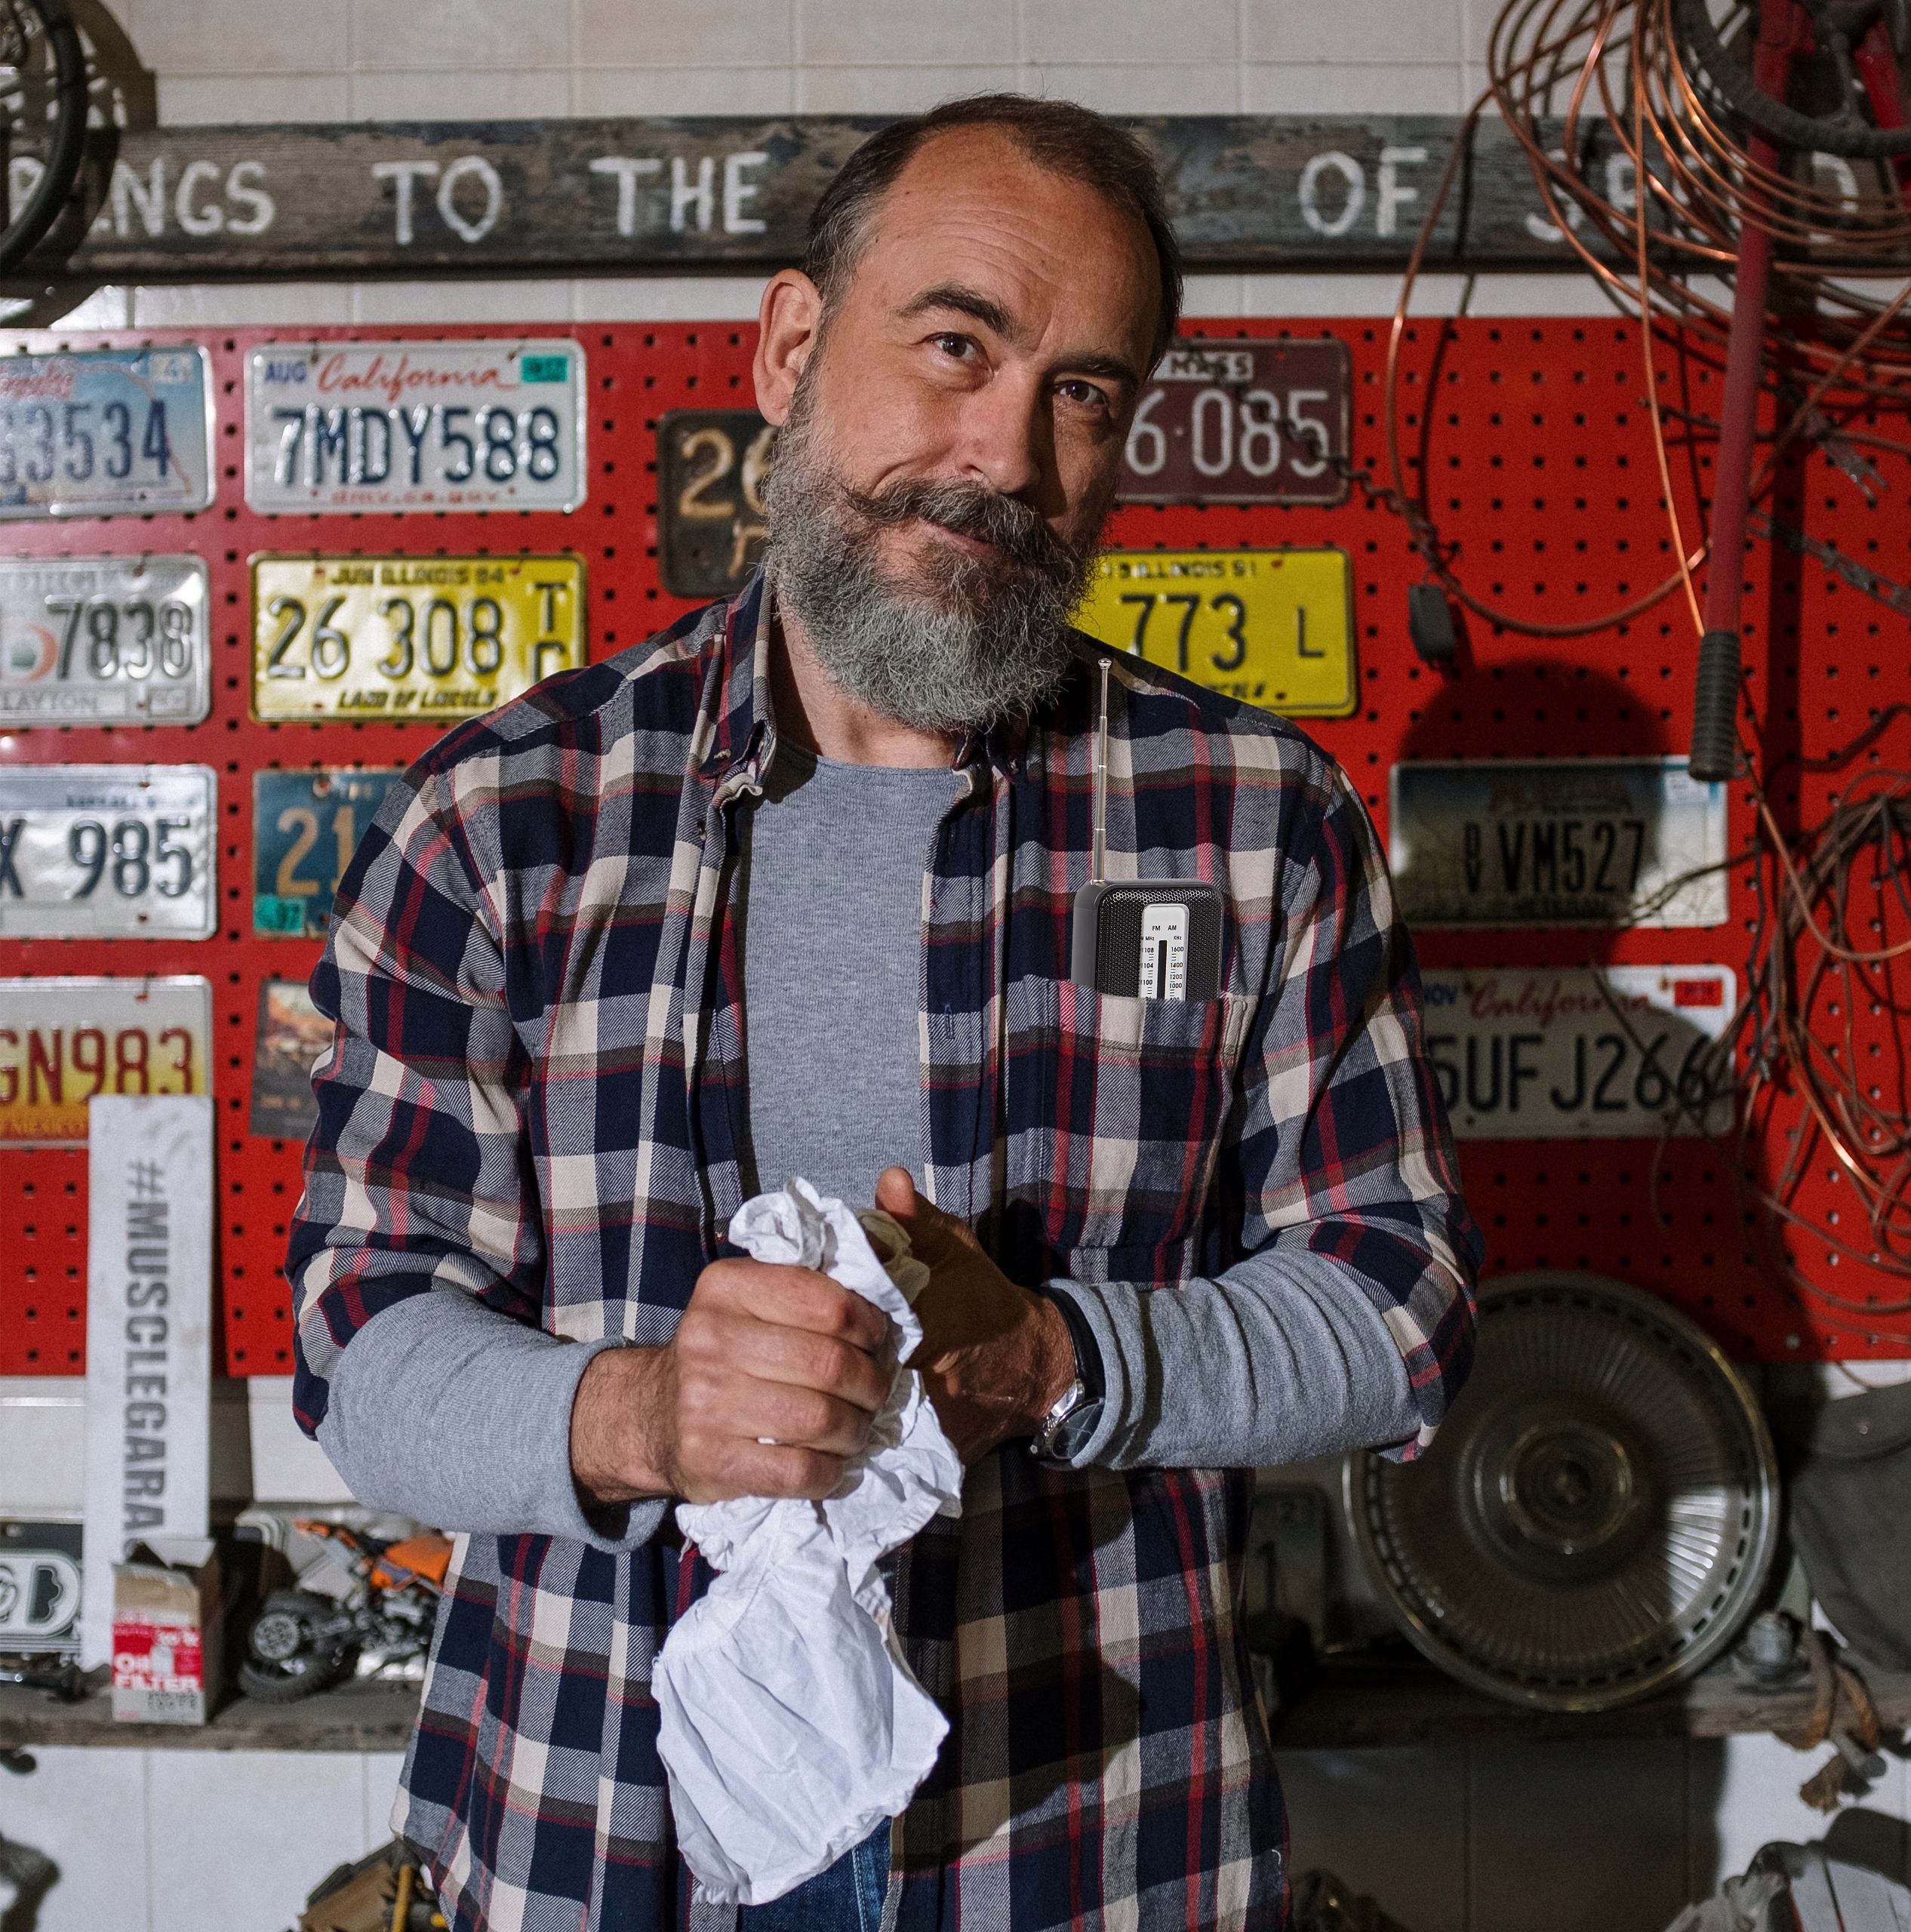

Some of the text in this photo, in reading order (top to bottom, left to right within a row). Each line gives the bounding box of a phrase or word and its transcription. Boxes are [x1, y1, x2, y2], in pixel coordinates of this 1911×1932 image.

[372, 154, 503, 245] TO
[589, 152, 770, 237] THE
[1298, 146, 1429, 238] OF
[264, 360, 307, 384] AUG
[317, 352, 521, 402] California
[270, 405, 559, 488] 7MDY588
[331, 566, 374, 586] JUN
[380, 566, 470, 585] ILLINOIS
[45, 594, 194, 681] 7838
[267, 595, 504, 681] 26 308
[1117, 592, 1325, 673] 773 L
[68, 818, 193, 899] 985
